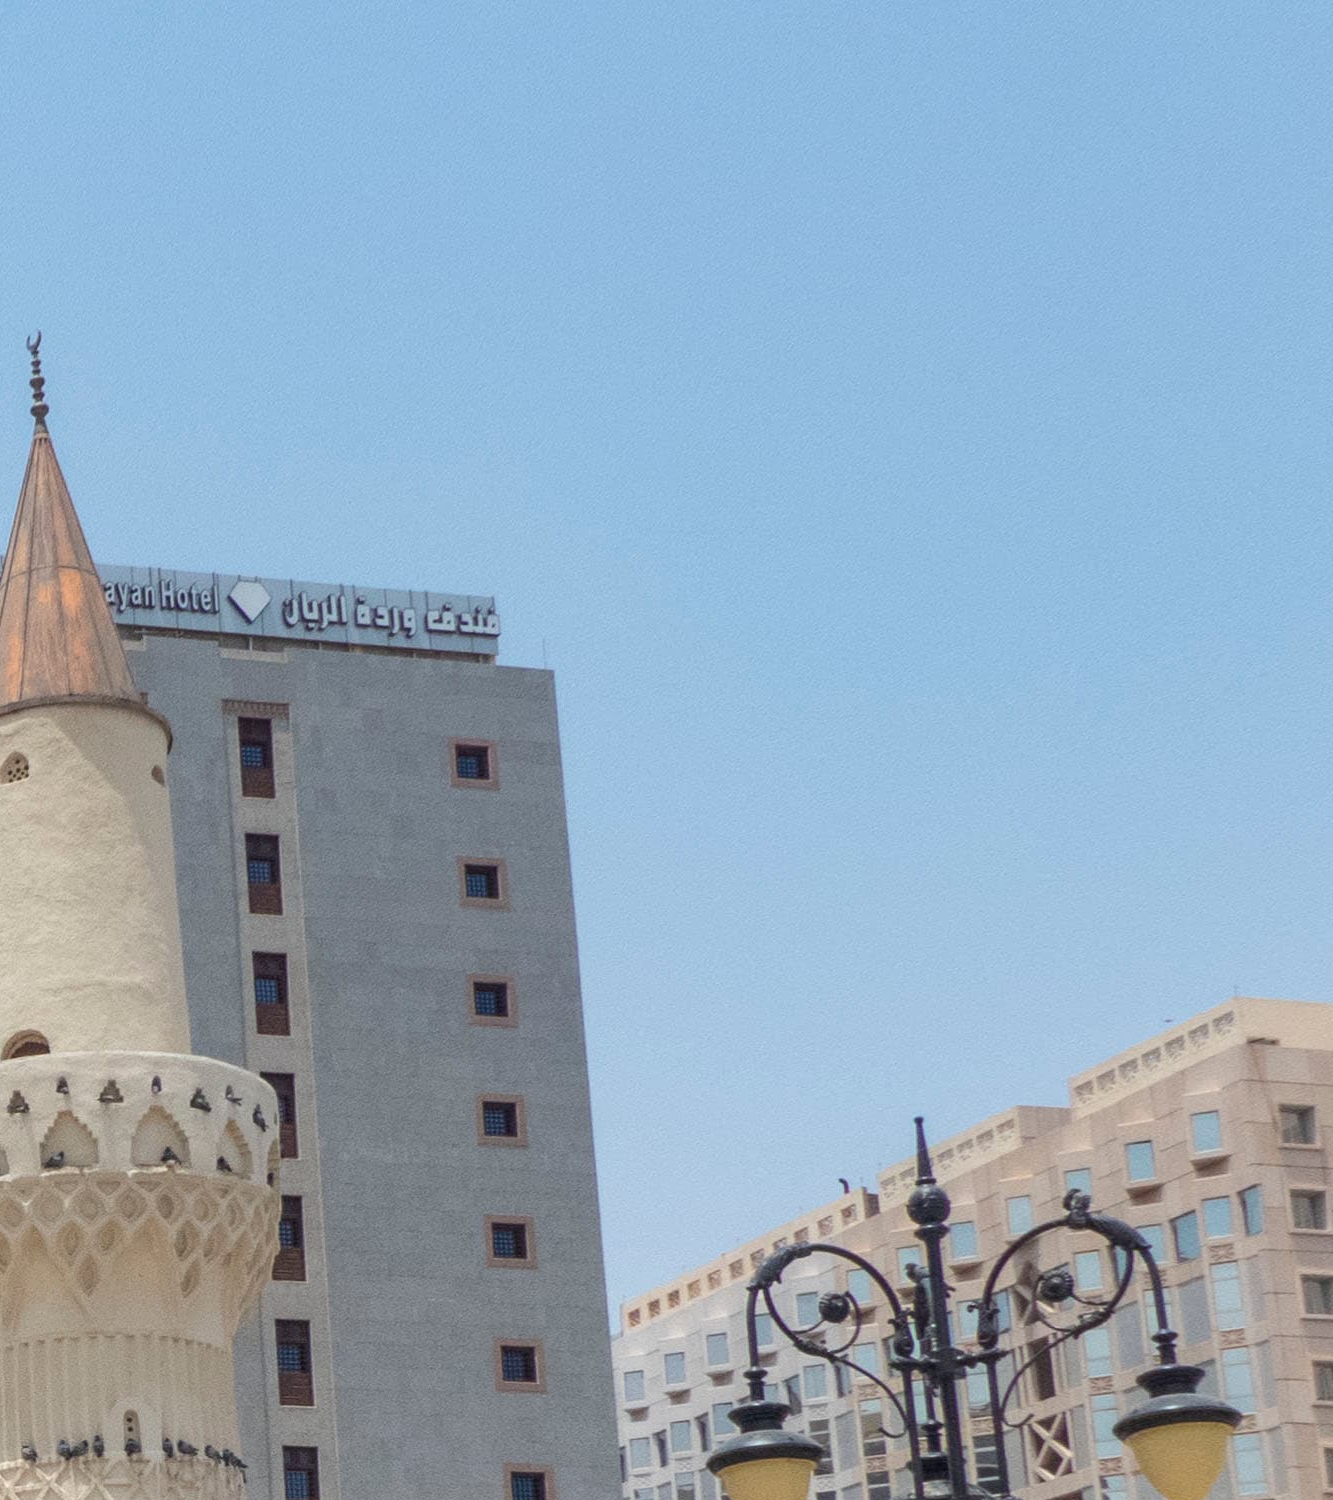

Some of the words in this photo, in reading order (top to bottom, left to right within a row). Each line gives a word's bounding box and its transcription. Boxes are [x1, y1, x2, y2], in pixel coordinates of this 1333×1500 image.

[104, 579, 156, 614] ayan
[159, 579, 220, 614] Hotel
[282, 589, 348, 633] الريان
[355, 594, 416, 639] وردة
[425, 602, 502, 638] فندق
